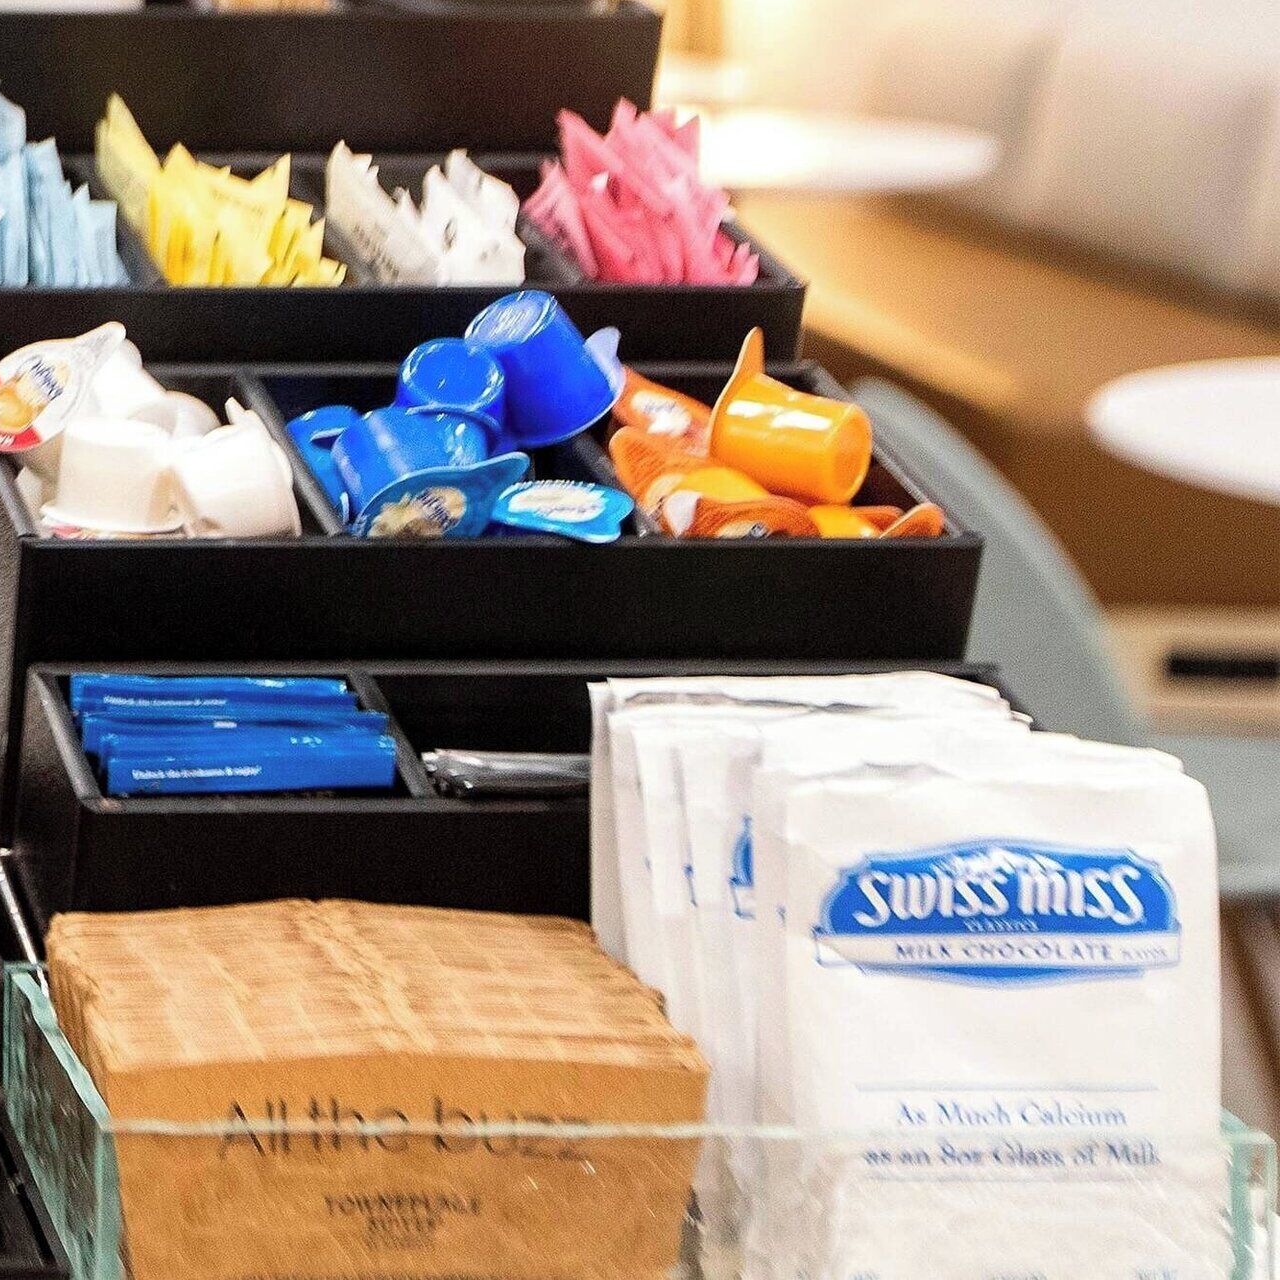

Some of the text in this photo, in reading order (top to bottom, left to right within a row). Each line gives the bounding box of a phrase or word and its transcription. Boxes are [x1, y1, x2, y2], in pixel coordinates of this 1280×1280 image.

[895, 940, 952, 960] MILK
[961, 939, 1114, 961] CHOCOLATE
[1018, 1099, 1128, 1125] Calcium
[217, 1096, 592, 1160] All the buzz
